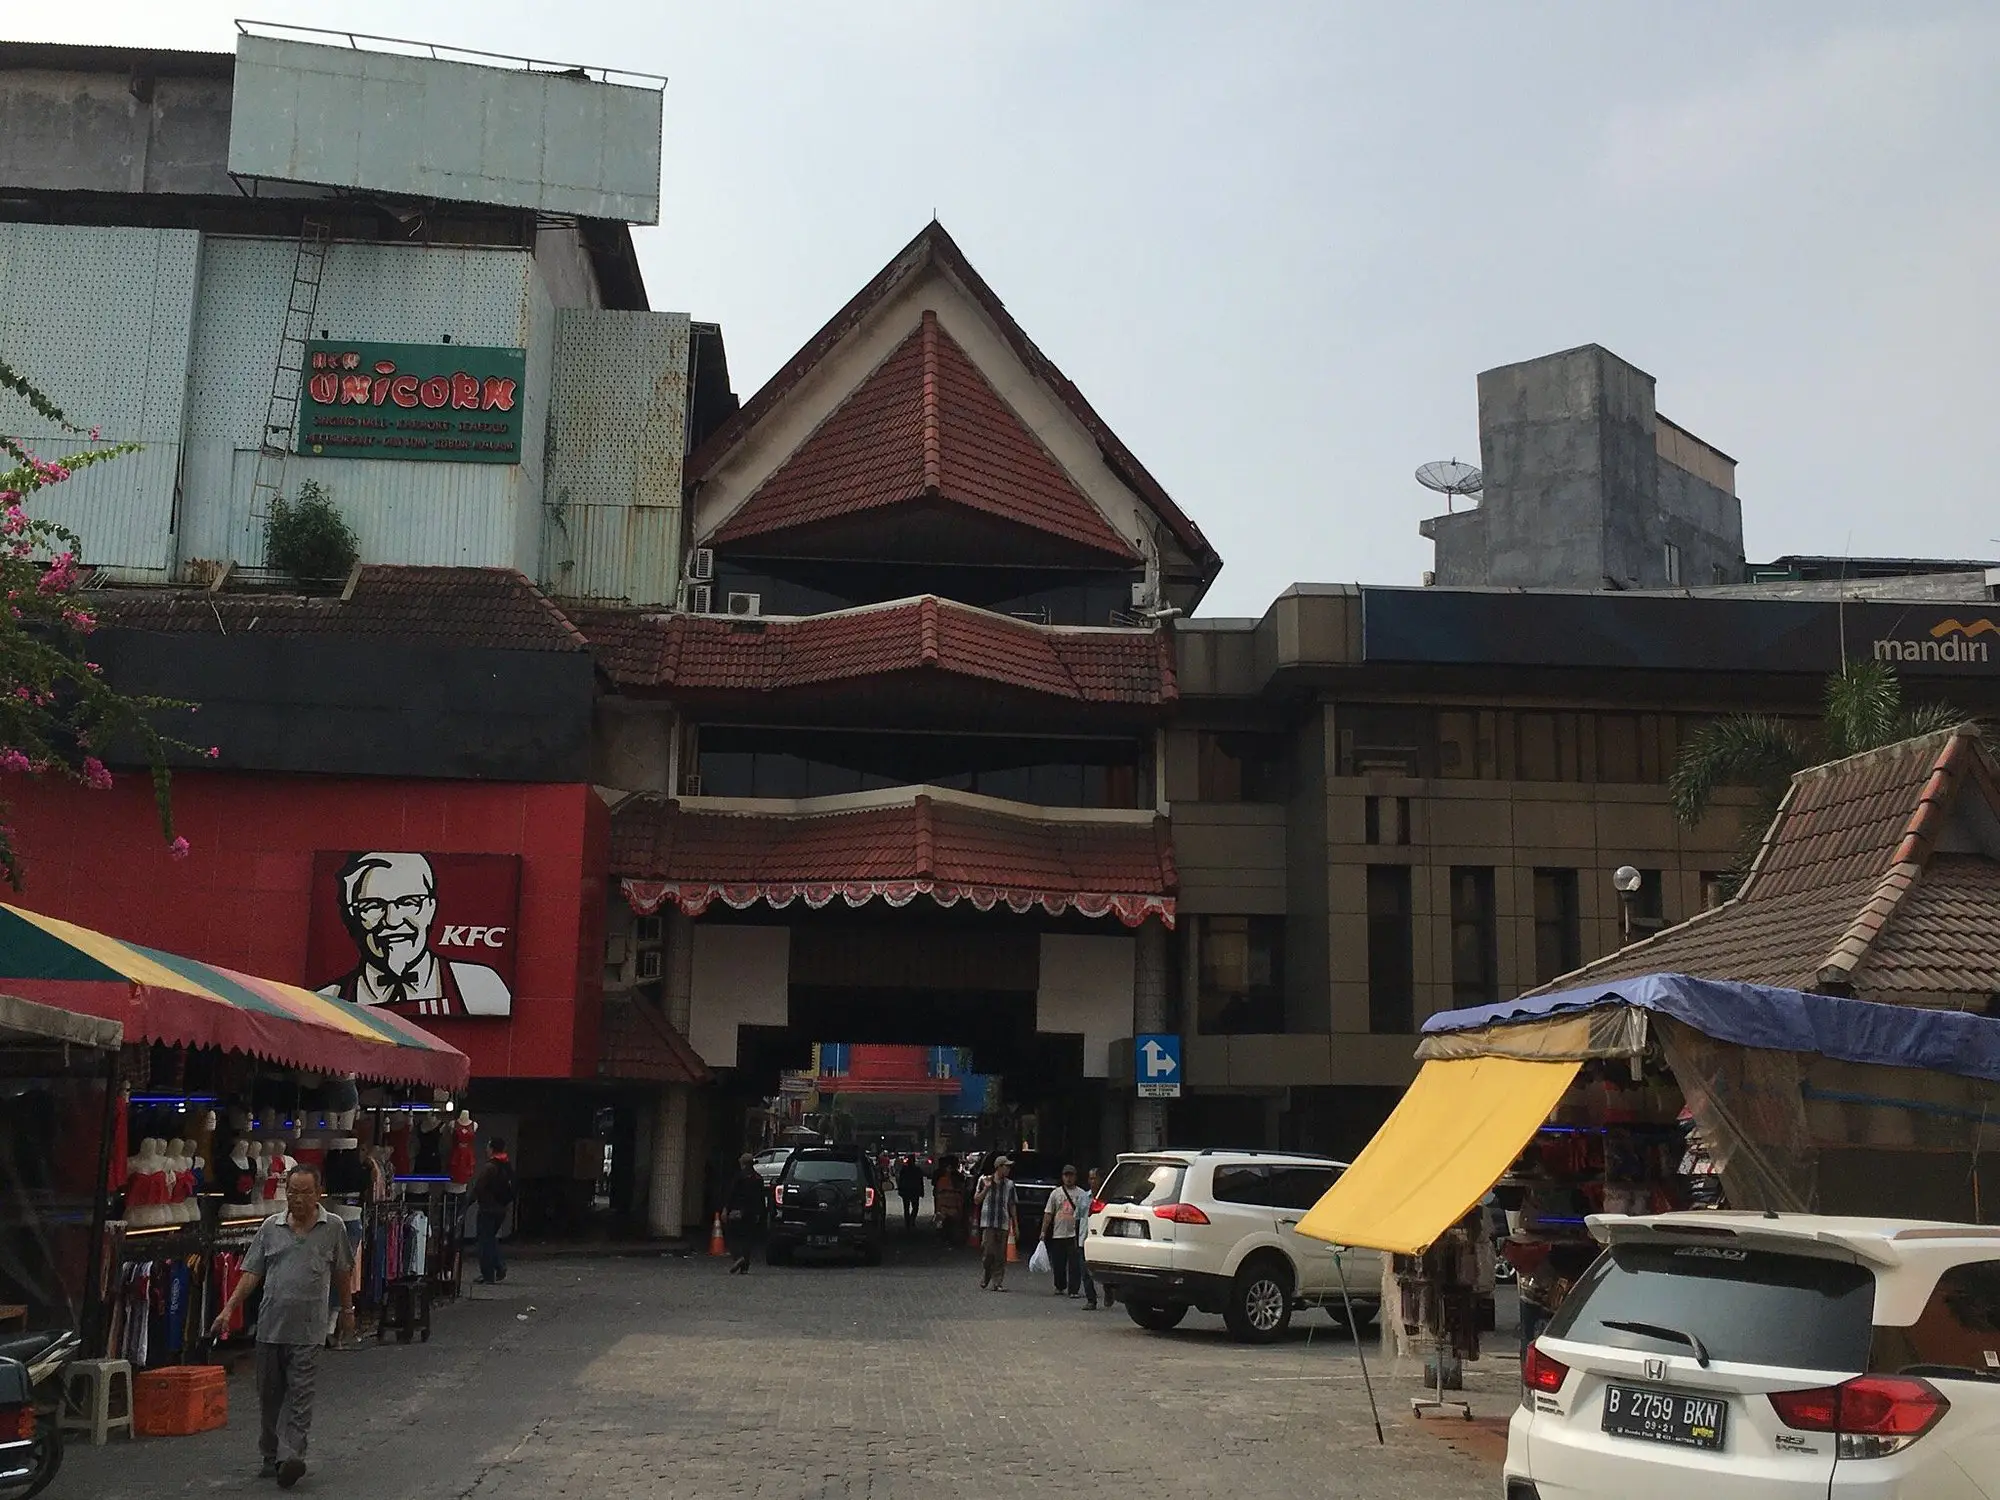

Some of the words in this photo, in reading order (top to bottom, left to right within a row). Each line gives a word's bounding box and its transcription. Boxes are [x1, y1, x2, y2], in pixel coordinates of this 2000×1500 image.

[1873, 635, 1988, 662] mandiri
[438, 925, 506, 948] KFC
[1609, 1389, 1621, 1413] B
[1630, 1393, 1673, 1421] 2759
[1683, 1400, 1718, 1428] BKN
